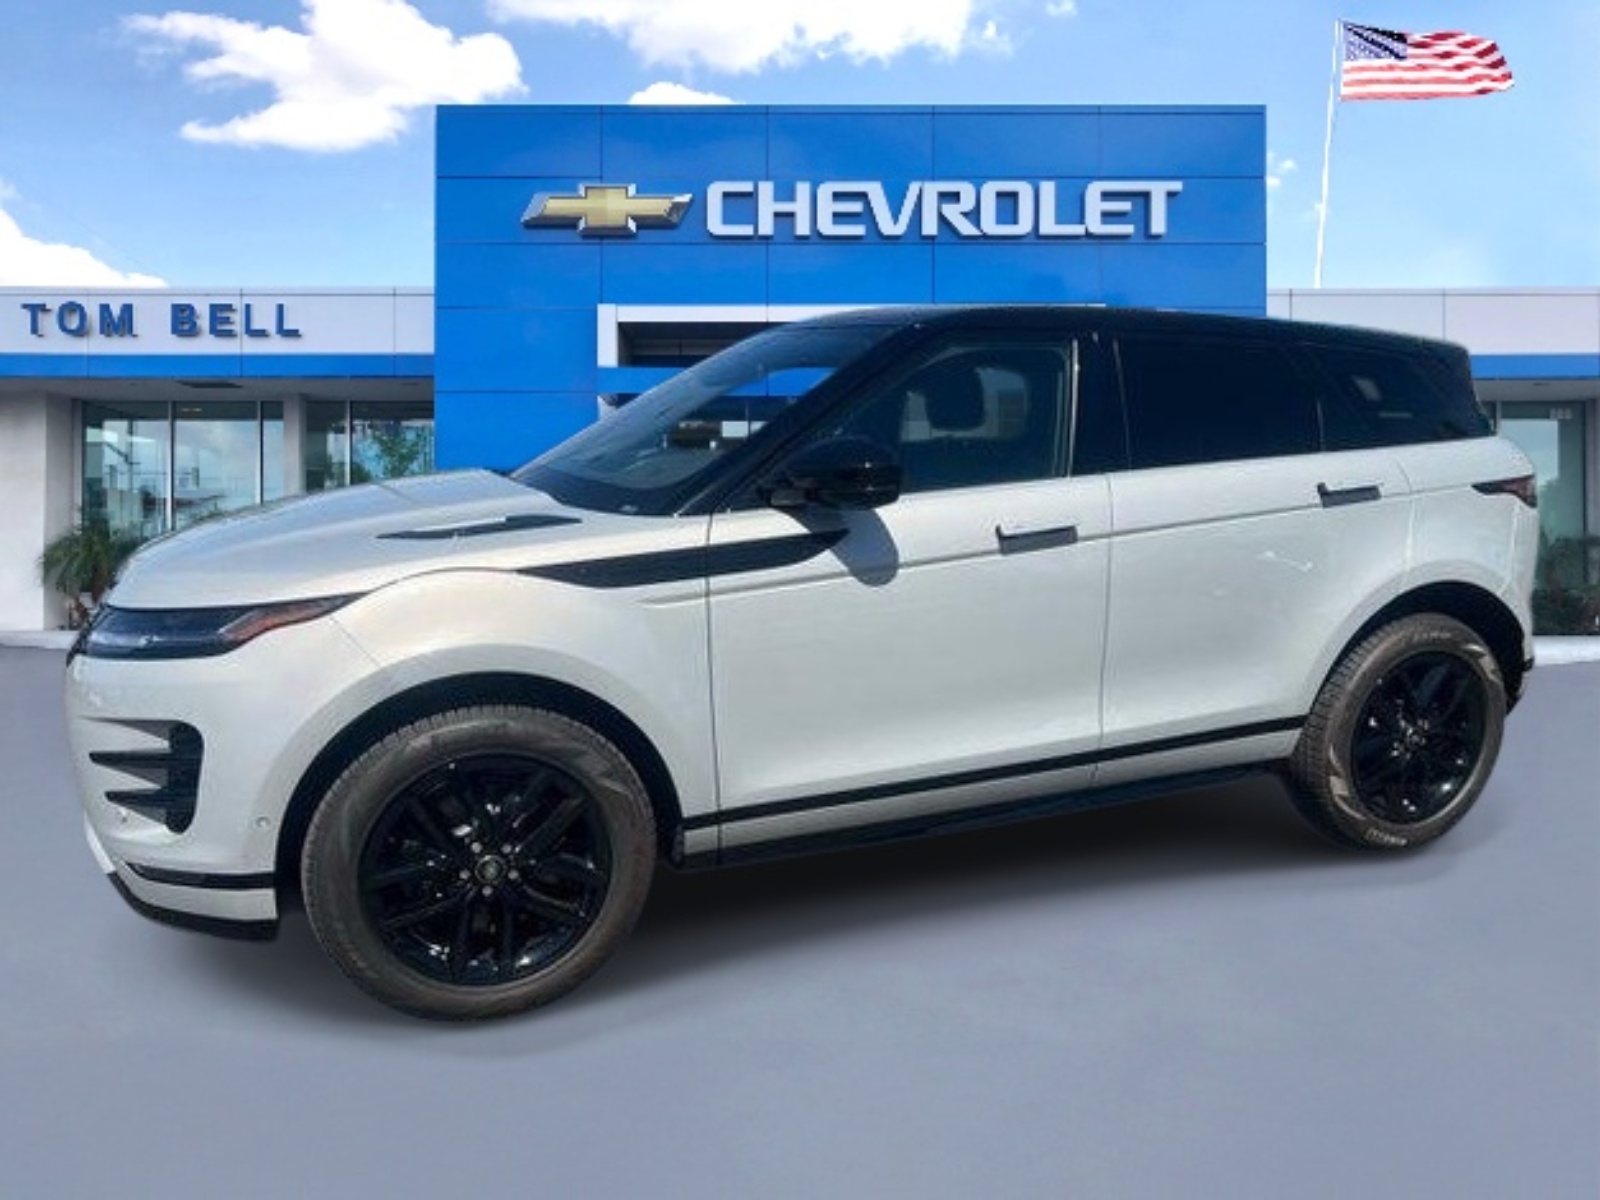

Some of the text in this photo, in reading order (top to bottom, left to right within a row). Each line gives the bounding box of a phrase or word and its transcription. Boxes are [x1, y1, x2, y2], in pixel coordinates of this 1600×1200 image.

[706, 180, 1184, 238] CHEVROLET
[21, 300, 303, 337] TOM BELL
